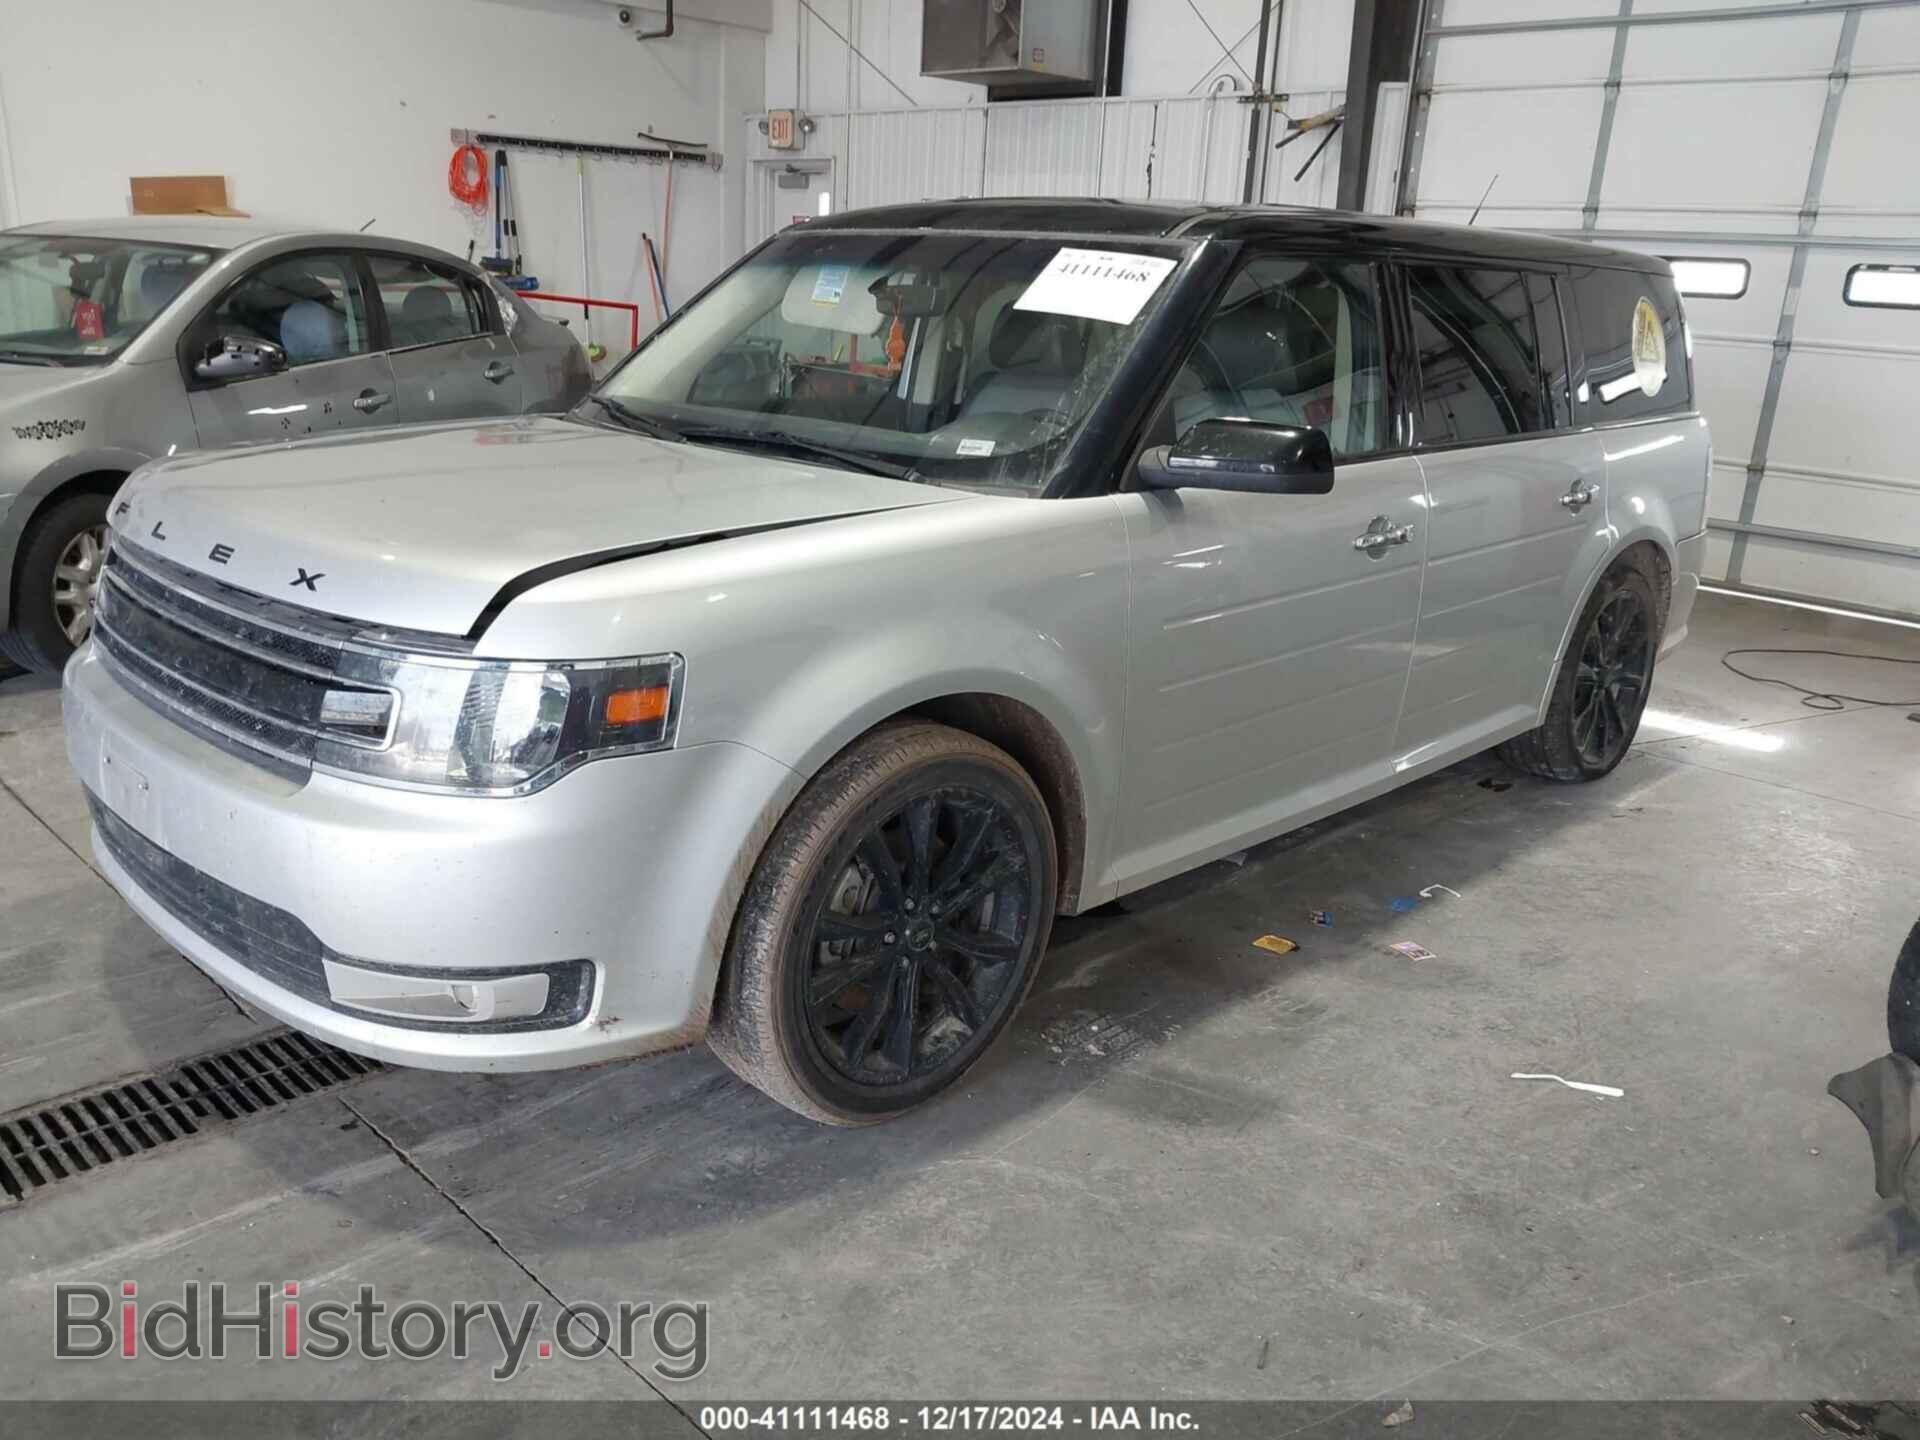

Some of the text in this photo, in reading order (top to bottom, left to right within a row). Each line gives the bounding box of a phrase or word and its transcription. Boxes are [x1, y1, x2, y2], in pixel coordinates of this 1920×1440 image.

[771, 117, 789, 140] EXIT
[1059, 263, 1151, 283] 41111468
[115, 501, 326, 592] FLEX
